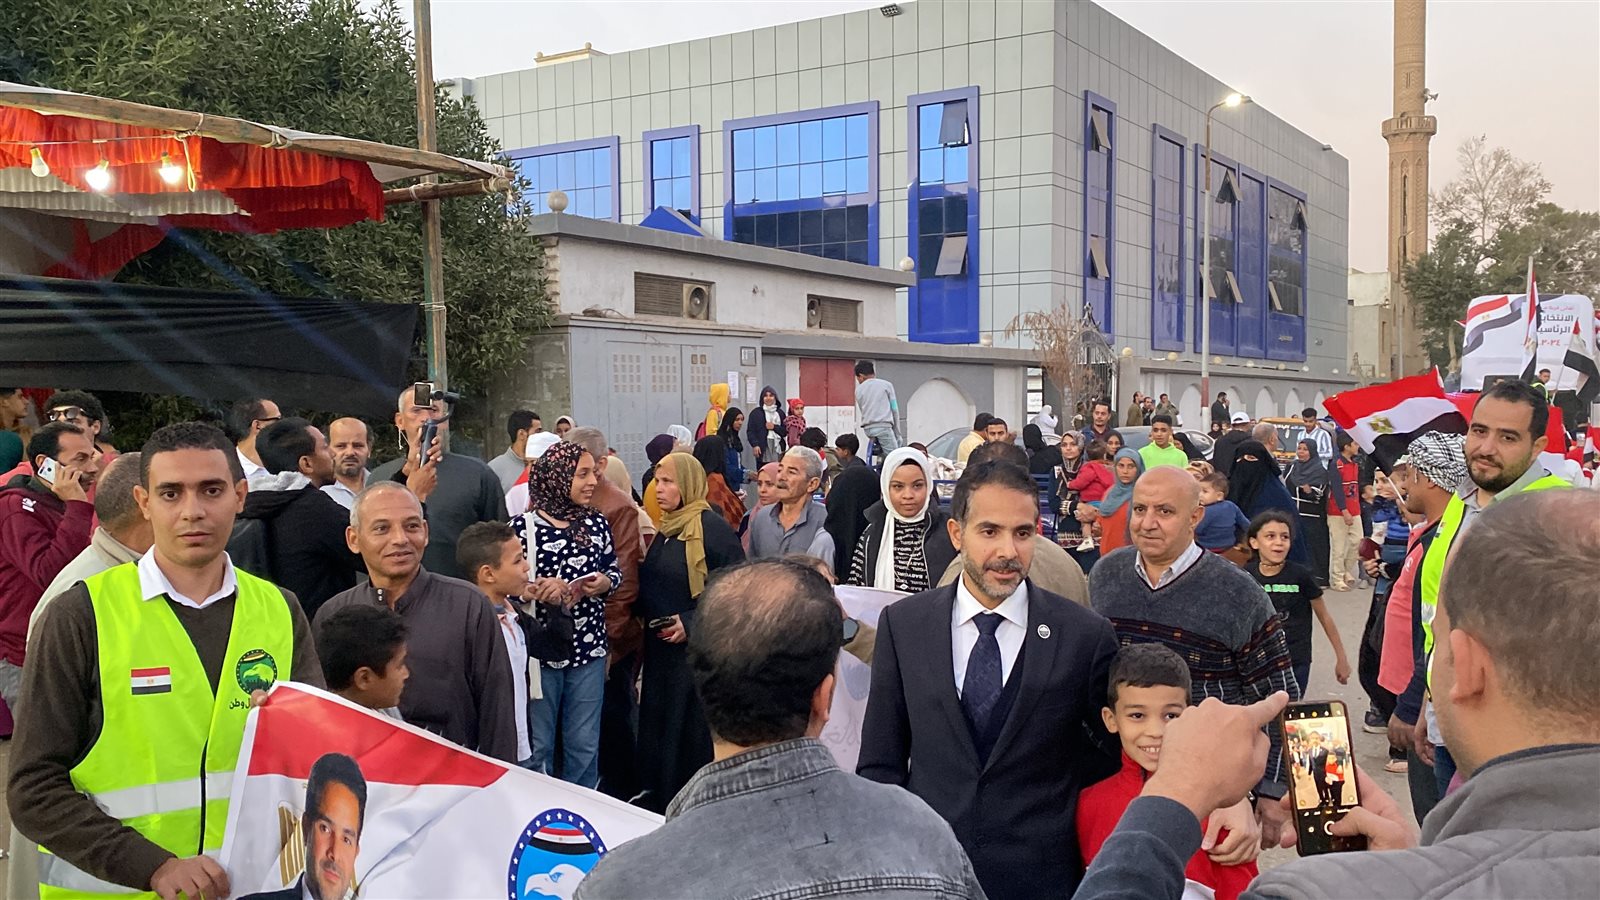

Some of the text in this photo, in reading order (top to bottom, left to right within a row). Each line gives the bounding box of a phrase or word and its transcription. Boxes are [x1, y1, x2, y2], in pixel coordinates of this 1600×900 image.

[1540, 313, 1574, 323] الانتخاب
[1536, 324, 1571, 335] الرئاسي
[229, 697, 245, 710] وطن
